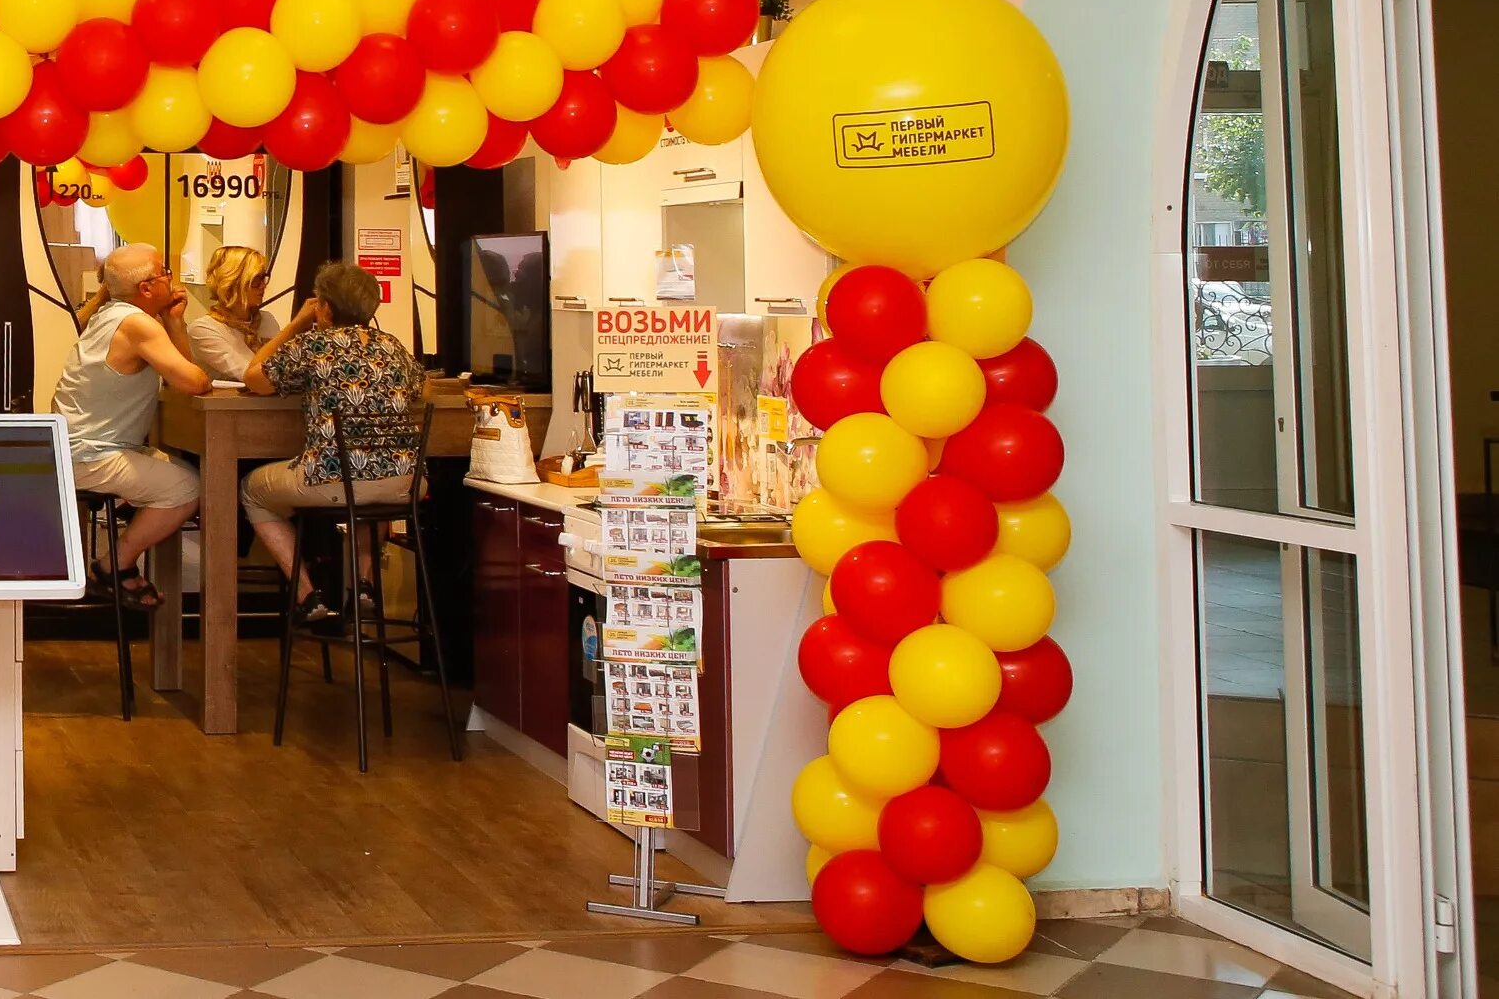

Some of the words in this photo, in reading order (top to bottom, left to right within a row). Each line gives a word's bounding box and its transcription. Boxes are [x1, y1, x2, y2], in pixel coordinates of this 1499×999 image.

[891, 115, 945, 132] ПЕРВЫЙ
[892, 126, 985, 145] ГИПЕРМАРКЕТ
[892, 144, 946, 157] МЕБЕЛИ
[59, 184, 91, 199] 220
[177, 175, 260, 199] 16990
[597, 310, 711, 334] ВОЗЬМИ
[598, 335, 711, 346] СПЕЦПРЕДЛОЖЕНИЕ!
[629, 351, 664, 360] ПЕРВЫЙ
[629, 361, 689, 369] ГИПЕРМАРКЕТ
[630, 369, 664, 377] МЕБЕЛИ
[634, 650, 667, 659] НИЗКИХ
